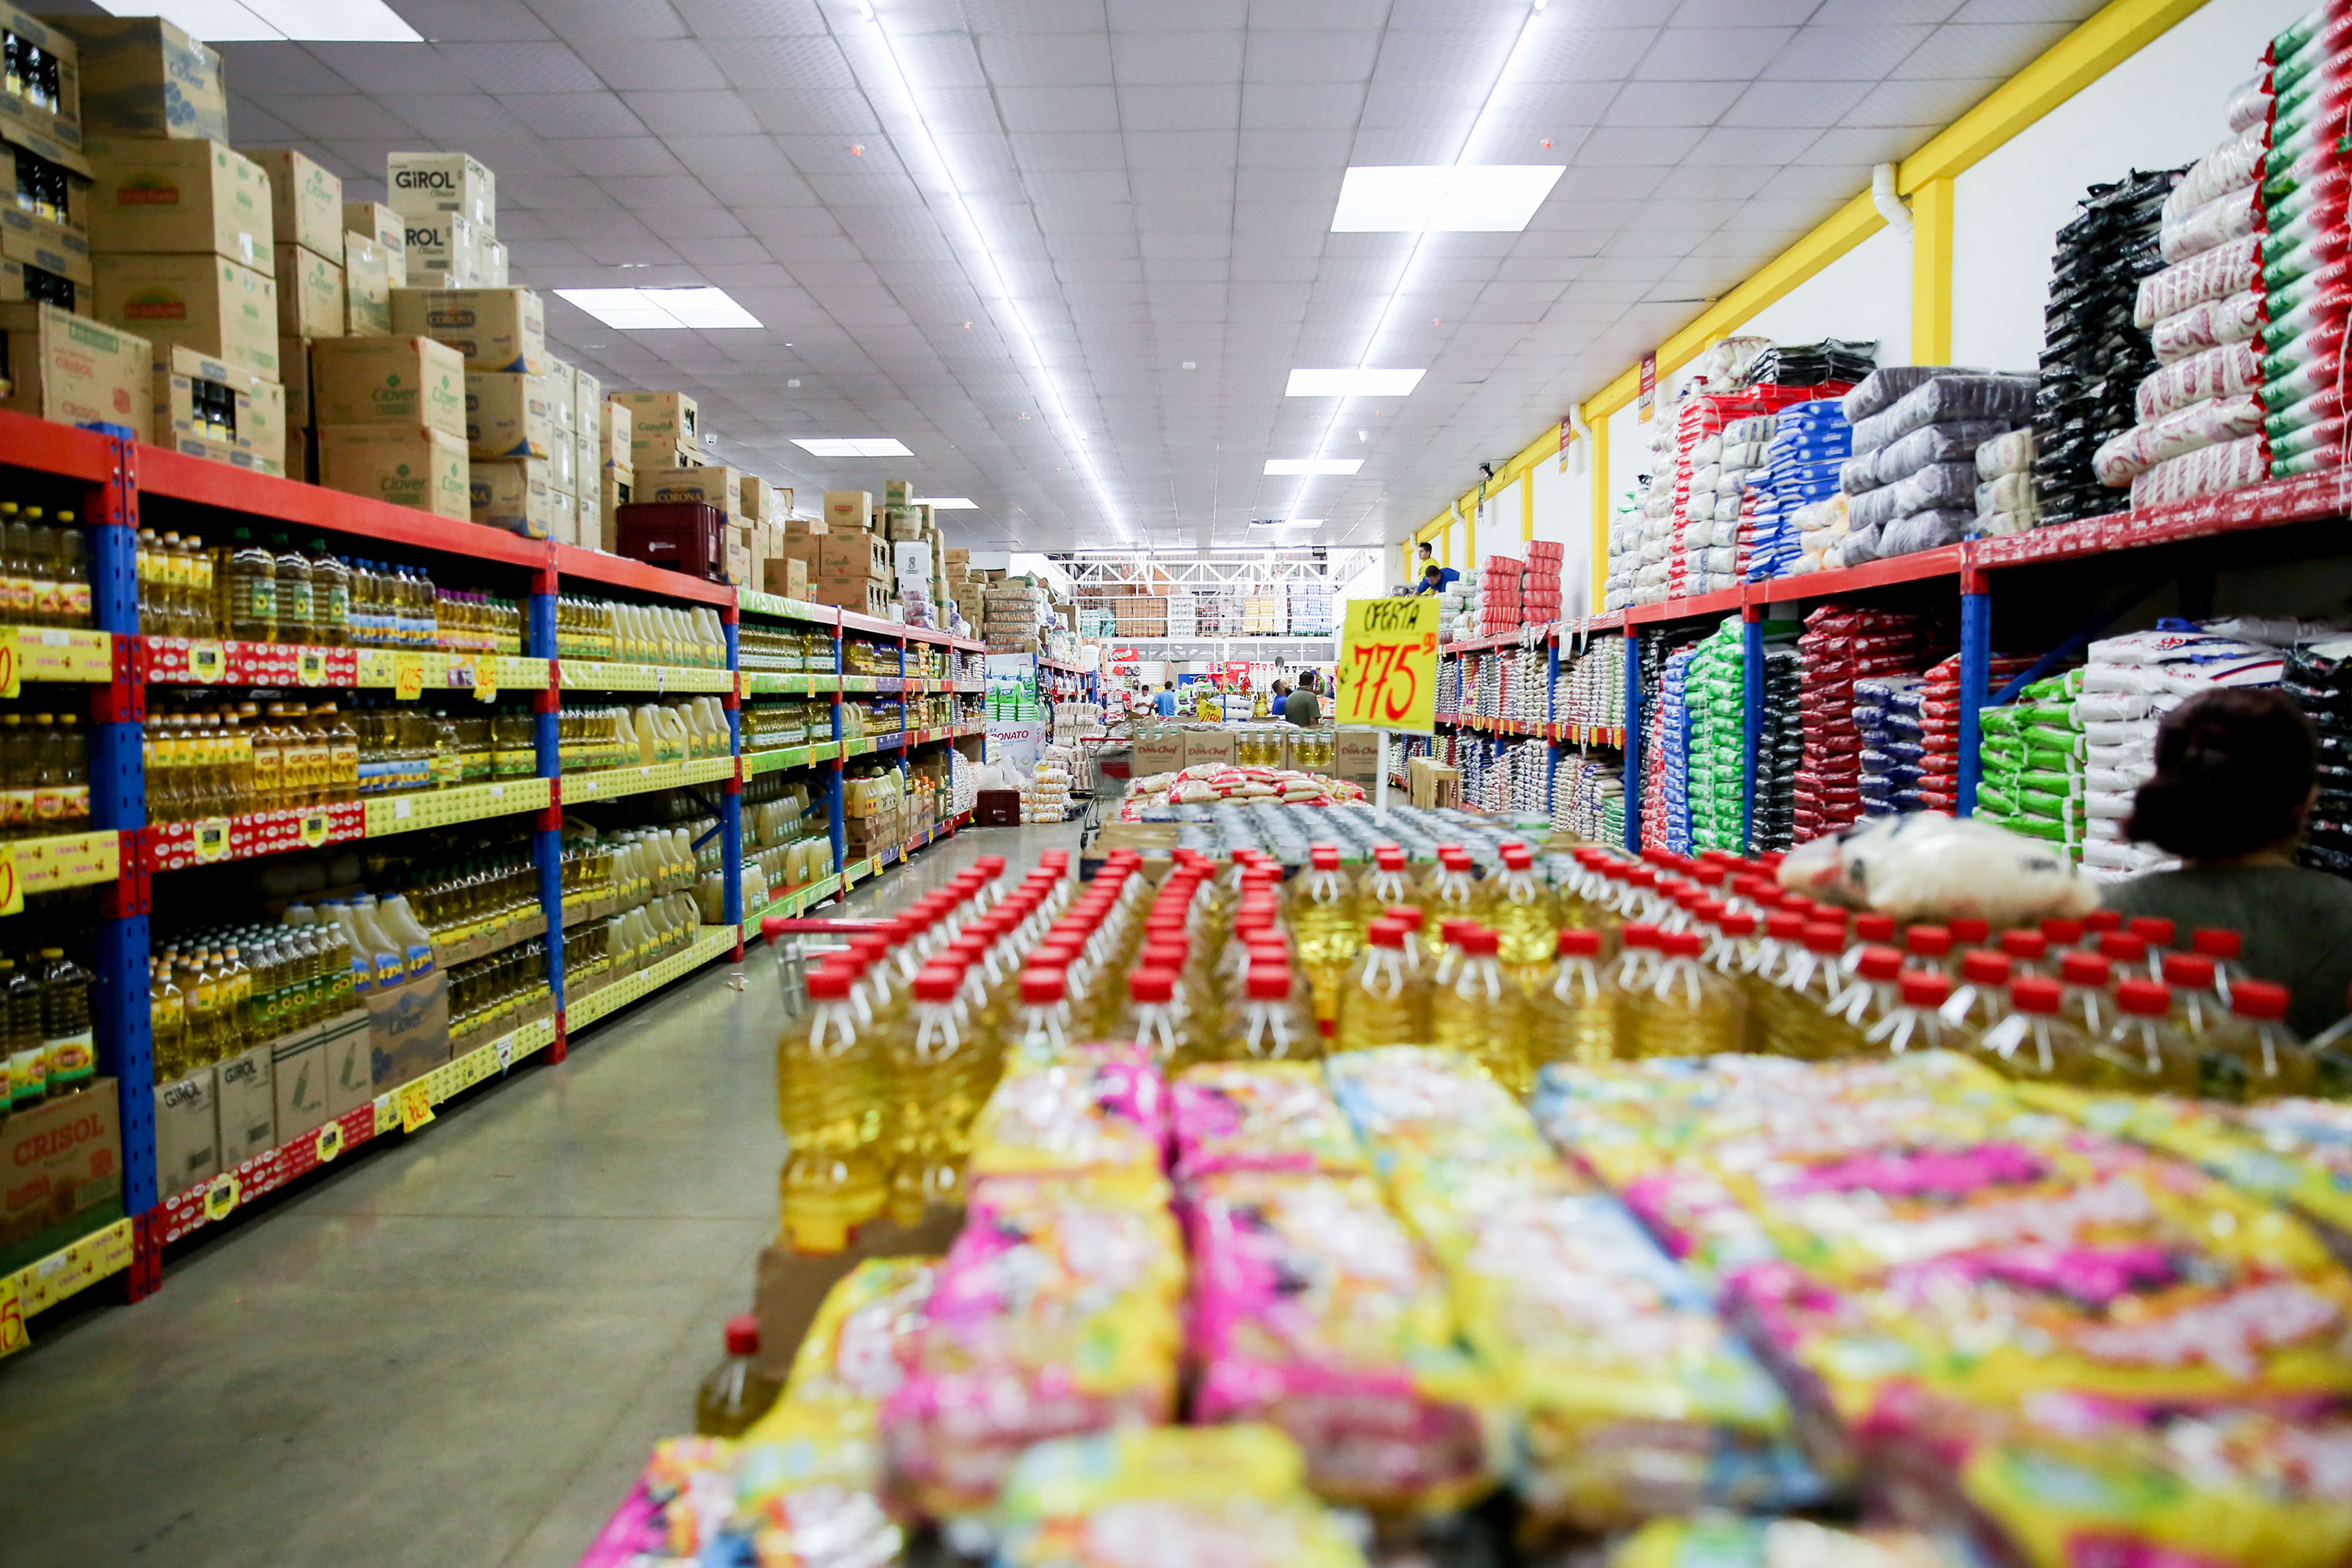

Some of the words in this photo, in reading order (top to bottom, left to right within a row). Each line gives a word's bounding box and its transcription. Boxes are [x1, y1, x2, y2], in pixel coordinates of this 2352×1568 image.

[395, 171, 456, 189] GiROL
[405, 229, 445, 246] ROL
[372, 388, 416, 401] Clover
[433, 386, 459, 407] Clover
[380, 476, 427, 491] Clover
[658, 492, 702, 502] CORONA
[1364, 600, 1420, 632] OFERTA
[1353, 643, 1421, 721] 775
[1157, 746, 1179, 754] Chef
[1208, 747, 1229, 756] Chef
[1361, 746, 1377, 755] Che
[15, 1112, 105, 1167] CRISOL
